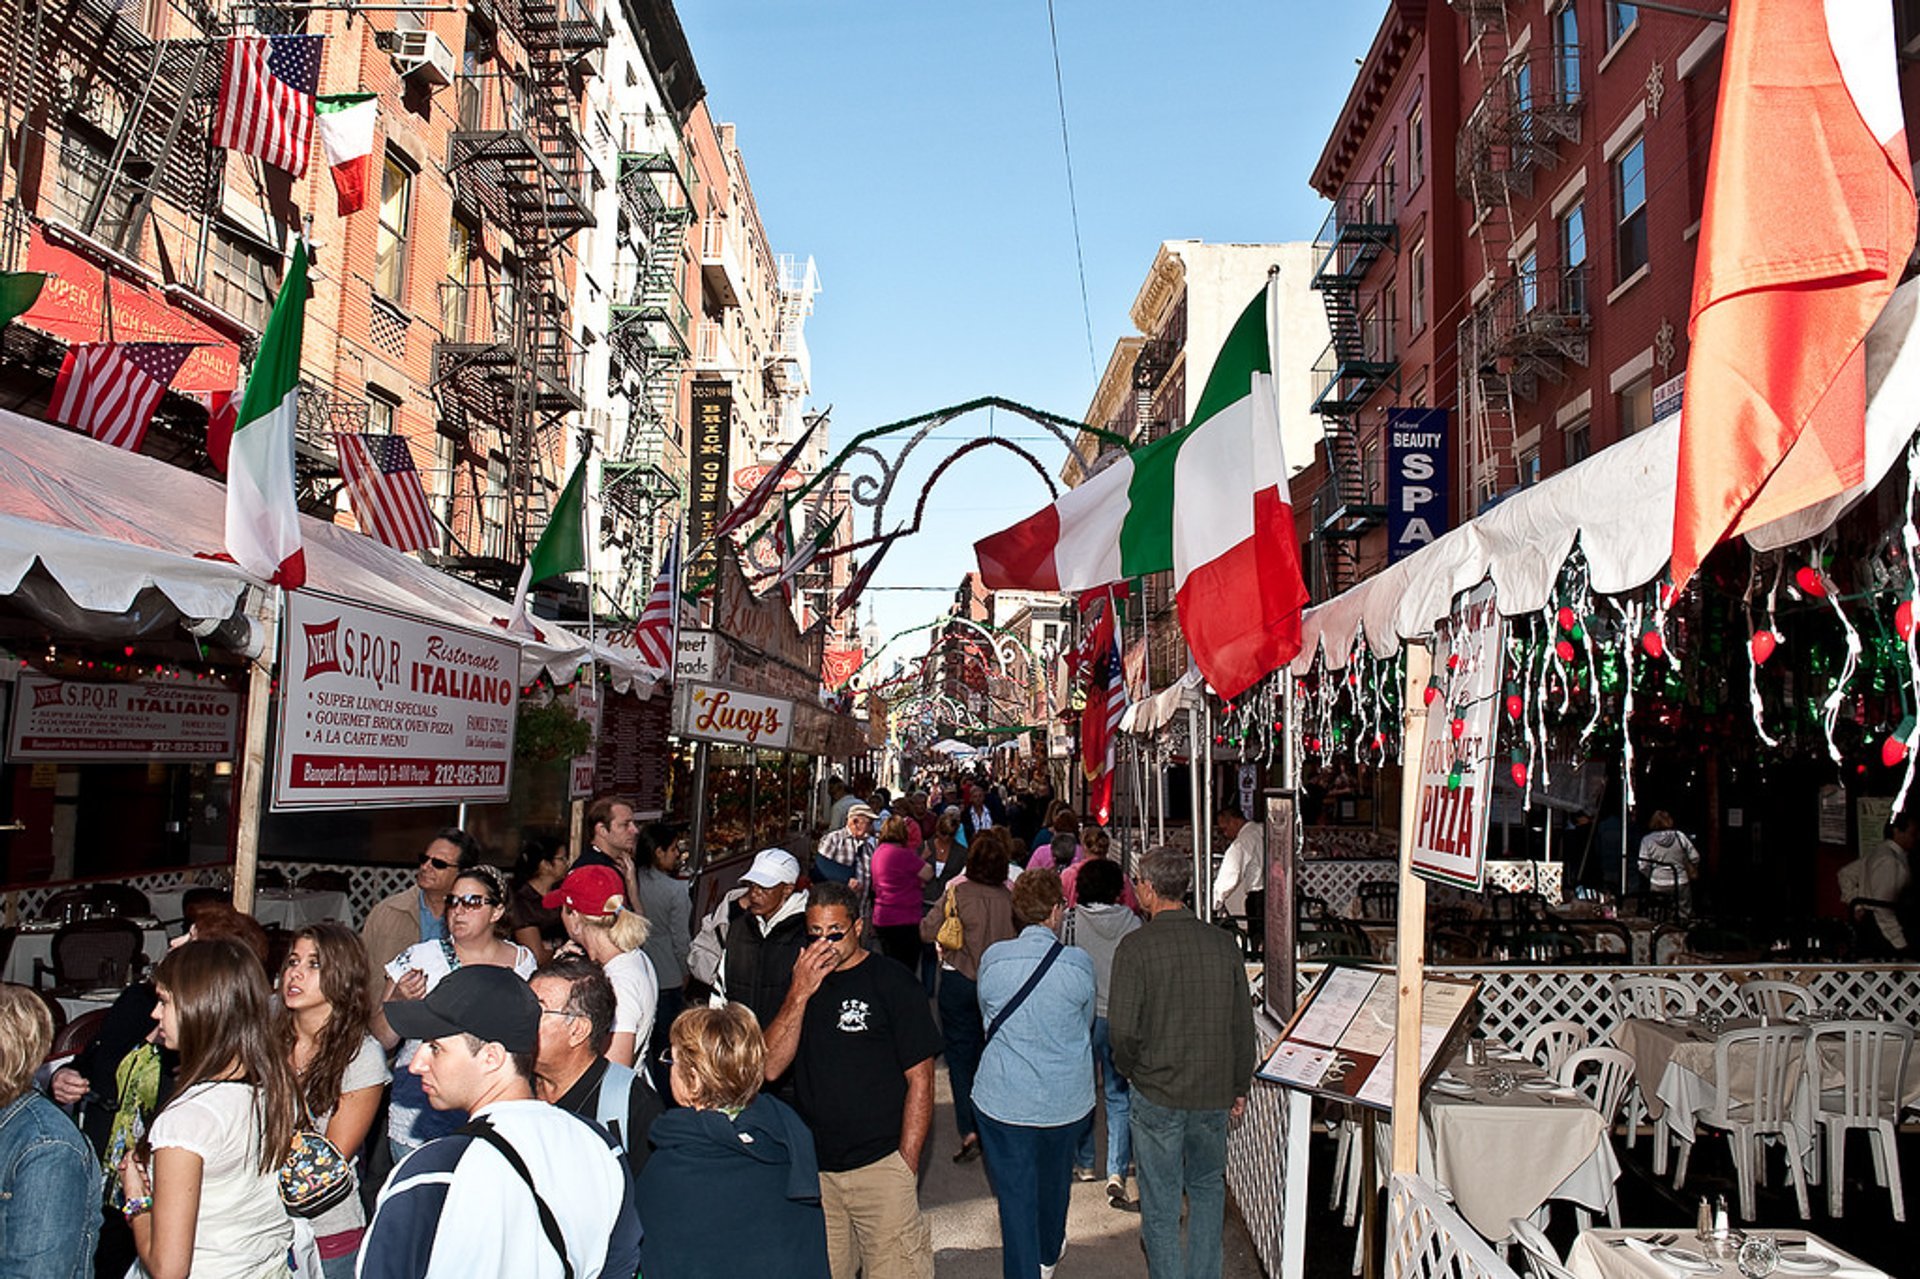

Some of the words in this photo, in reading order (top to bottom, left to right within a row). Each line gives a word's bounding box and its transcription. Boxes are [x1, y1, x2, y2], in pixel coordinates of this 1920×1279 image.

[200, 348, 233, 375] DAILY
[699, 404, 722, 455] BRICK
[1393, 432, 1441, 448] BEAUTY
[1399, 453, 1435, 543] SPA
[308, 630, 336, 667] NEW
[426, 635, 500, 672] Ristorante
[680, 635, 707, 652] eet
[410, 662, 512, 706] ITALIANO
[127, 698, 230, 716] ITALIANO
[316, 691, 354, 709] SUPER
[357, 697, 393, 713] LUNCH
[394, 701, 439, 718] SPECIALS
[696, 692, 783, 741] Lucy's
[315, 710, 371, 728] GOURMET
[372, 715, 404, 731] BRICK
[405, 718, 429, 733] OVEN
[430, 721, 454, 735] PIZZA
[313, 729, 323, 743] A
[326, 730, 341, 744] LA
[343, 731, 378, 747] CARTE
[379, 734, 408, 748] MENU
[303, 762, 337, 786] Banquet
[338, 763, 357, 786] Party
[357, 763, 378, 782] Room
[378, 764, 389, 785] Up
[389, 764, 397, 782] To
[1417, 785, 1474, 858] PIZZA
